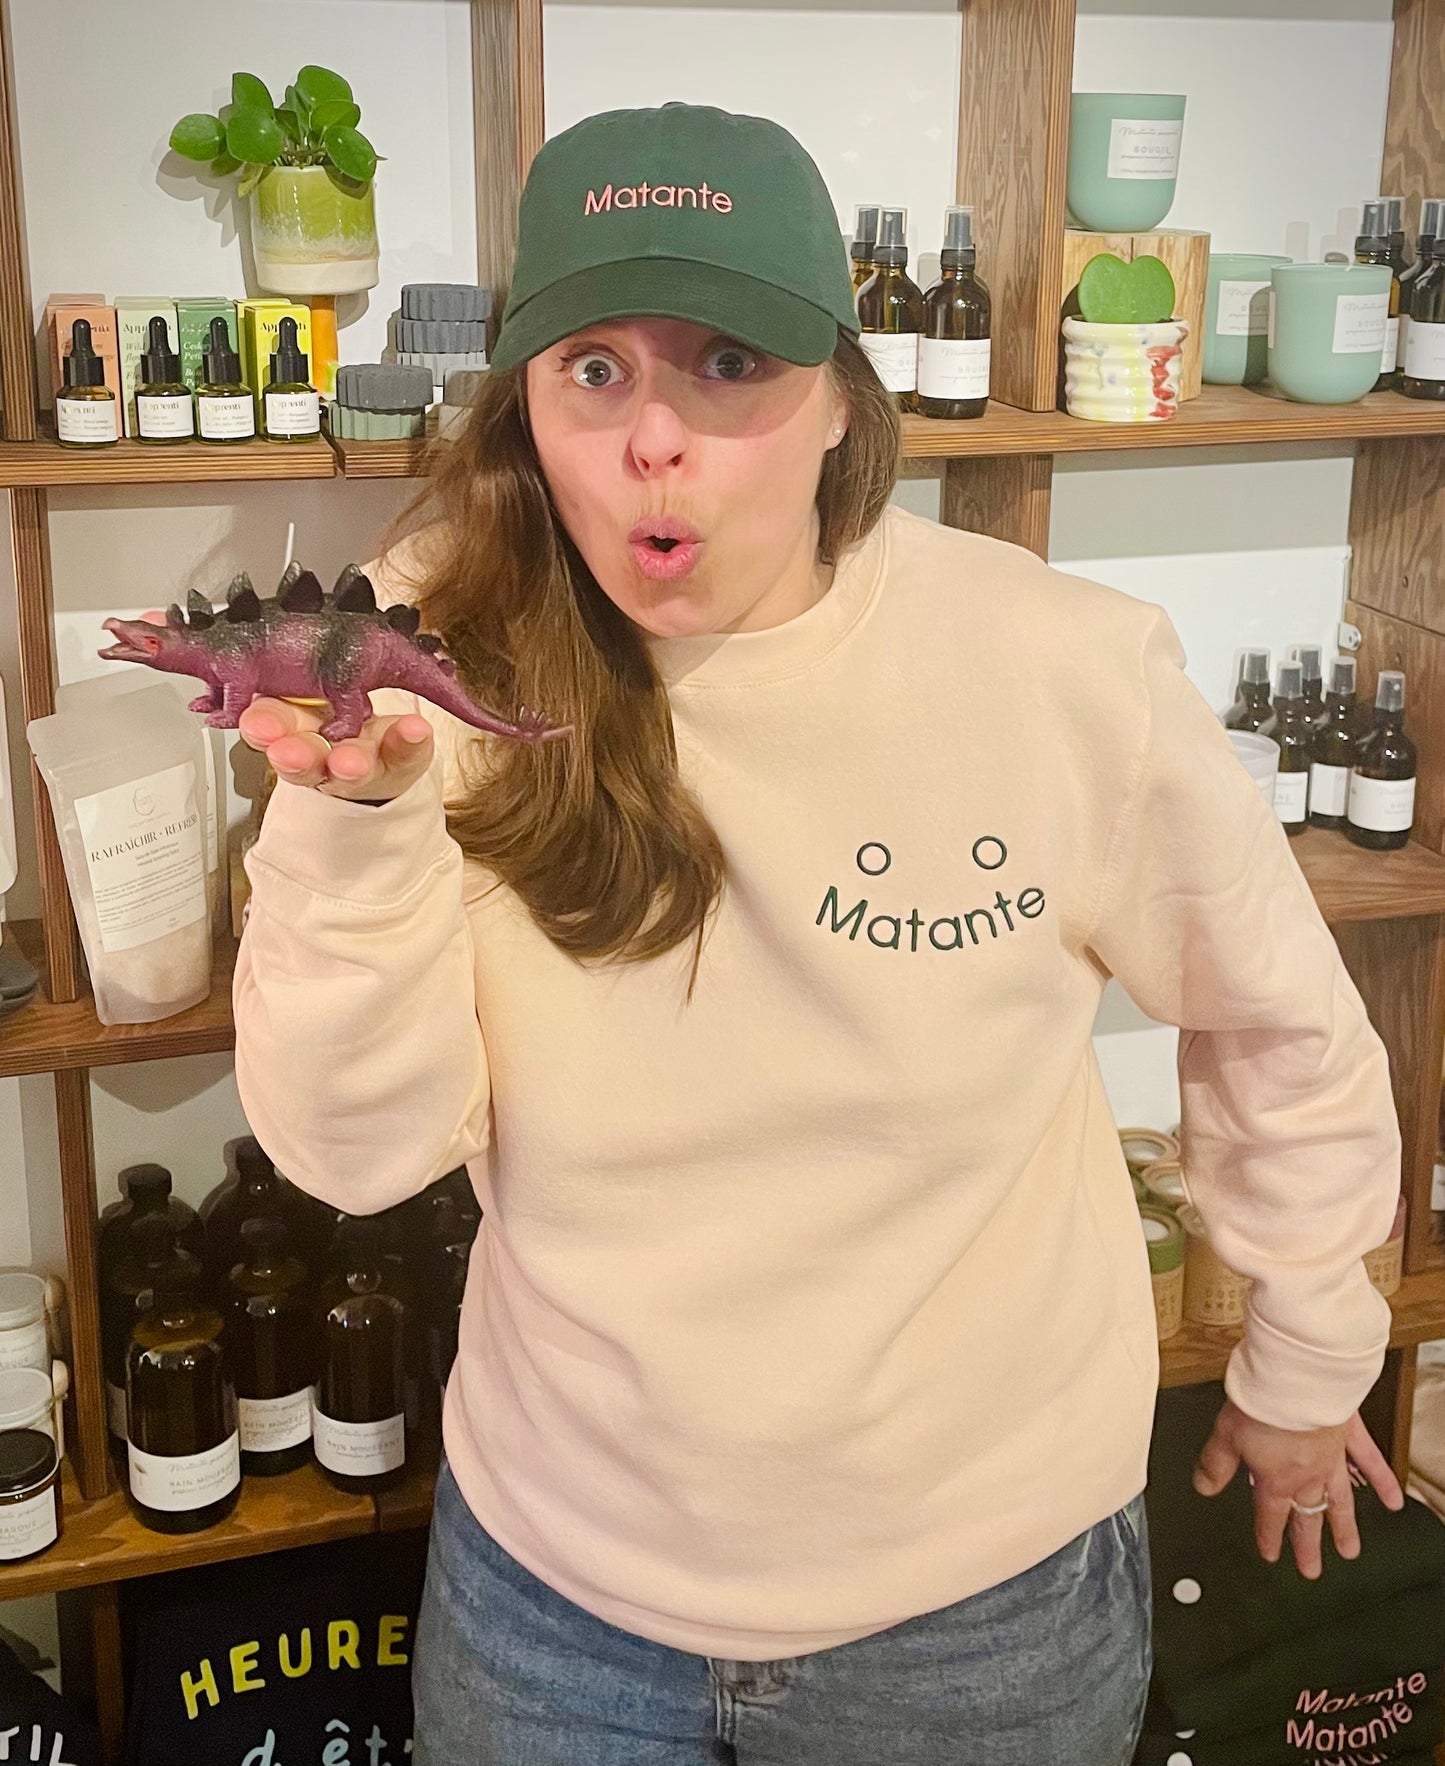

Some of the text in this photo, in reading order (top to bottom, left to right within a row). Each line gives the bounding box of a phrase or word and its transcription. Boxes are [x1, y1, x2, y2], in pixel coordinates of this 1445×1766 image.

[584, 181, 733, 216] Matante
[815, 885, 1046, 953] Matante
[1286, 1701, 1414, 1752] Matante
